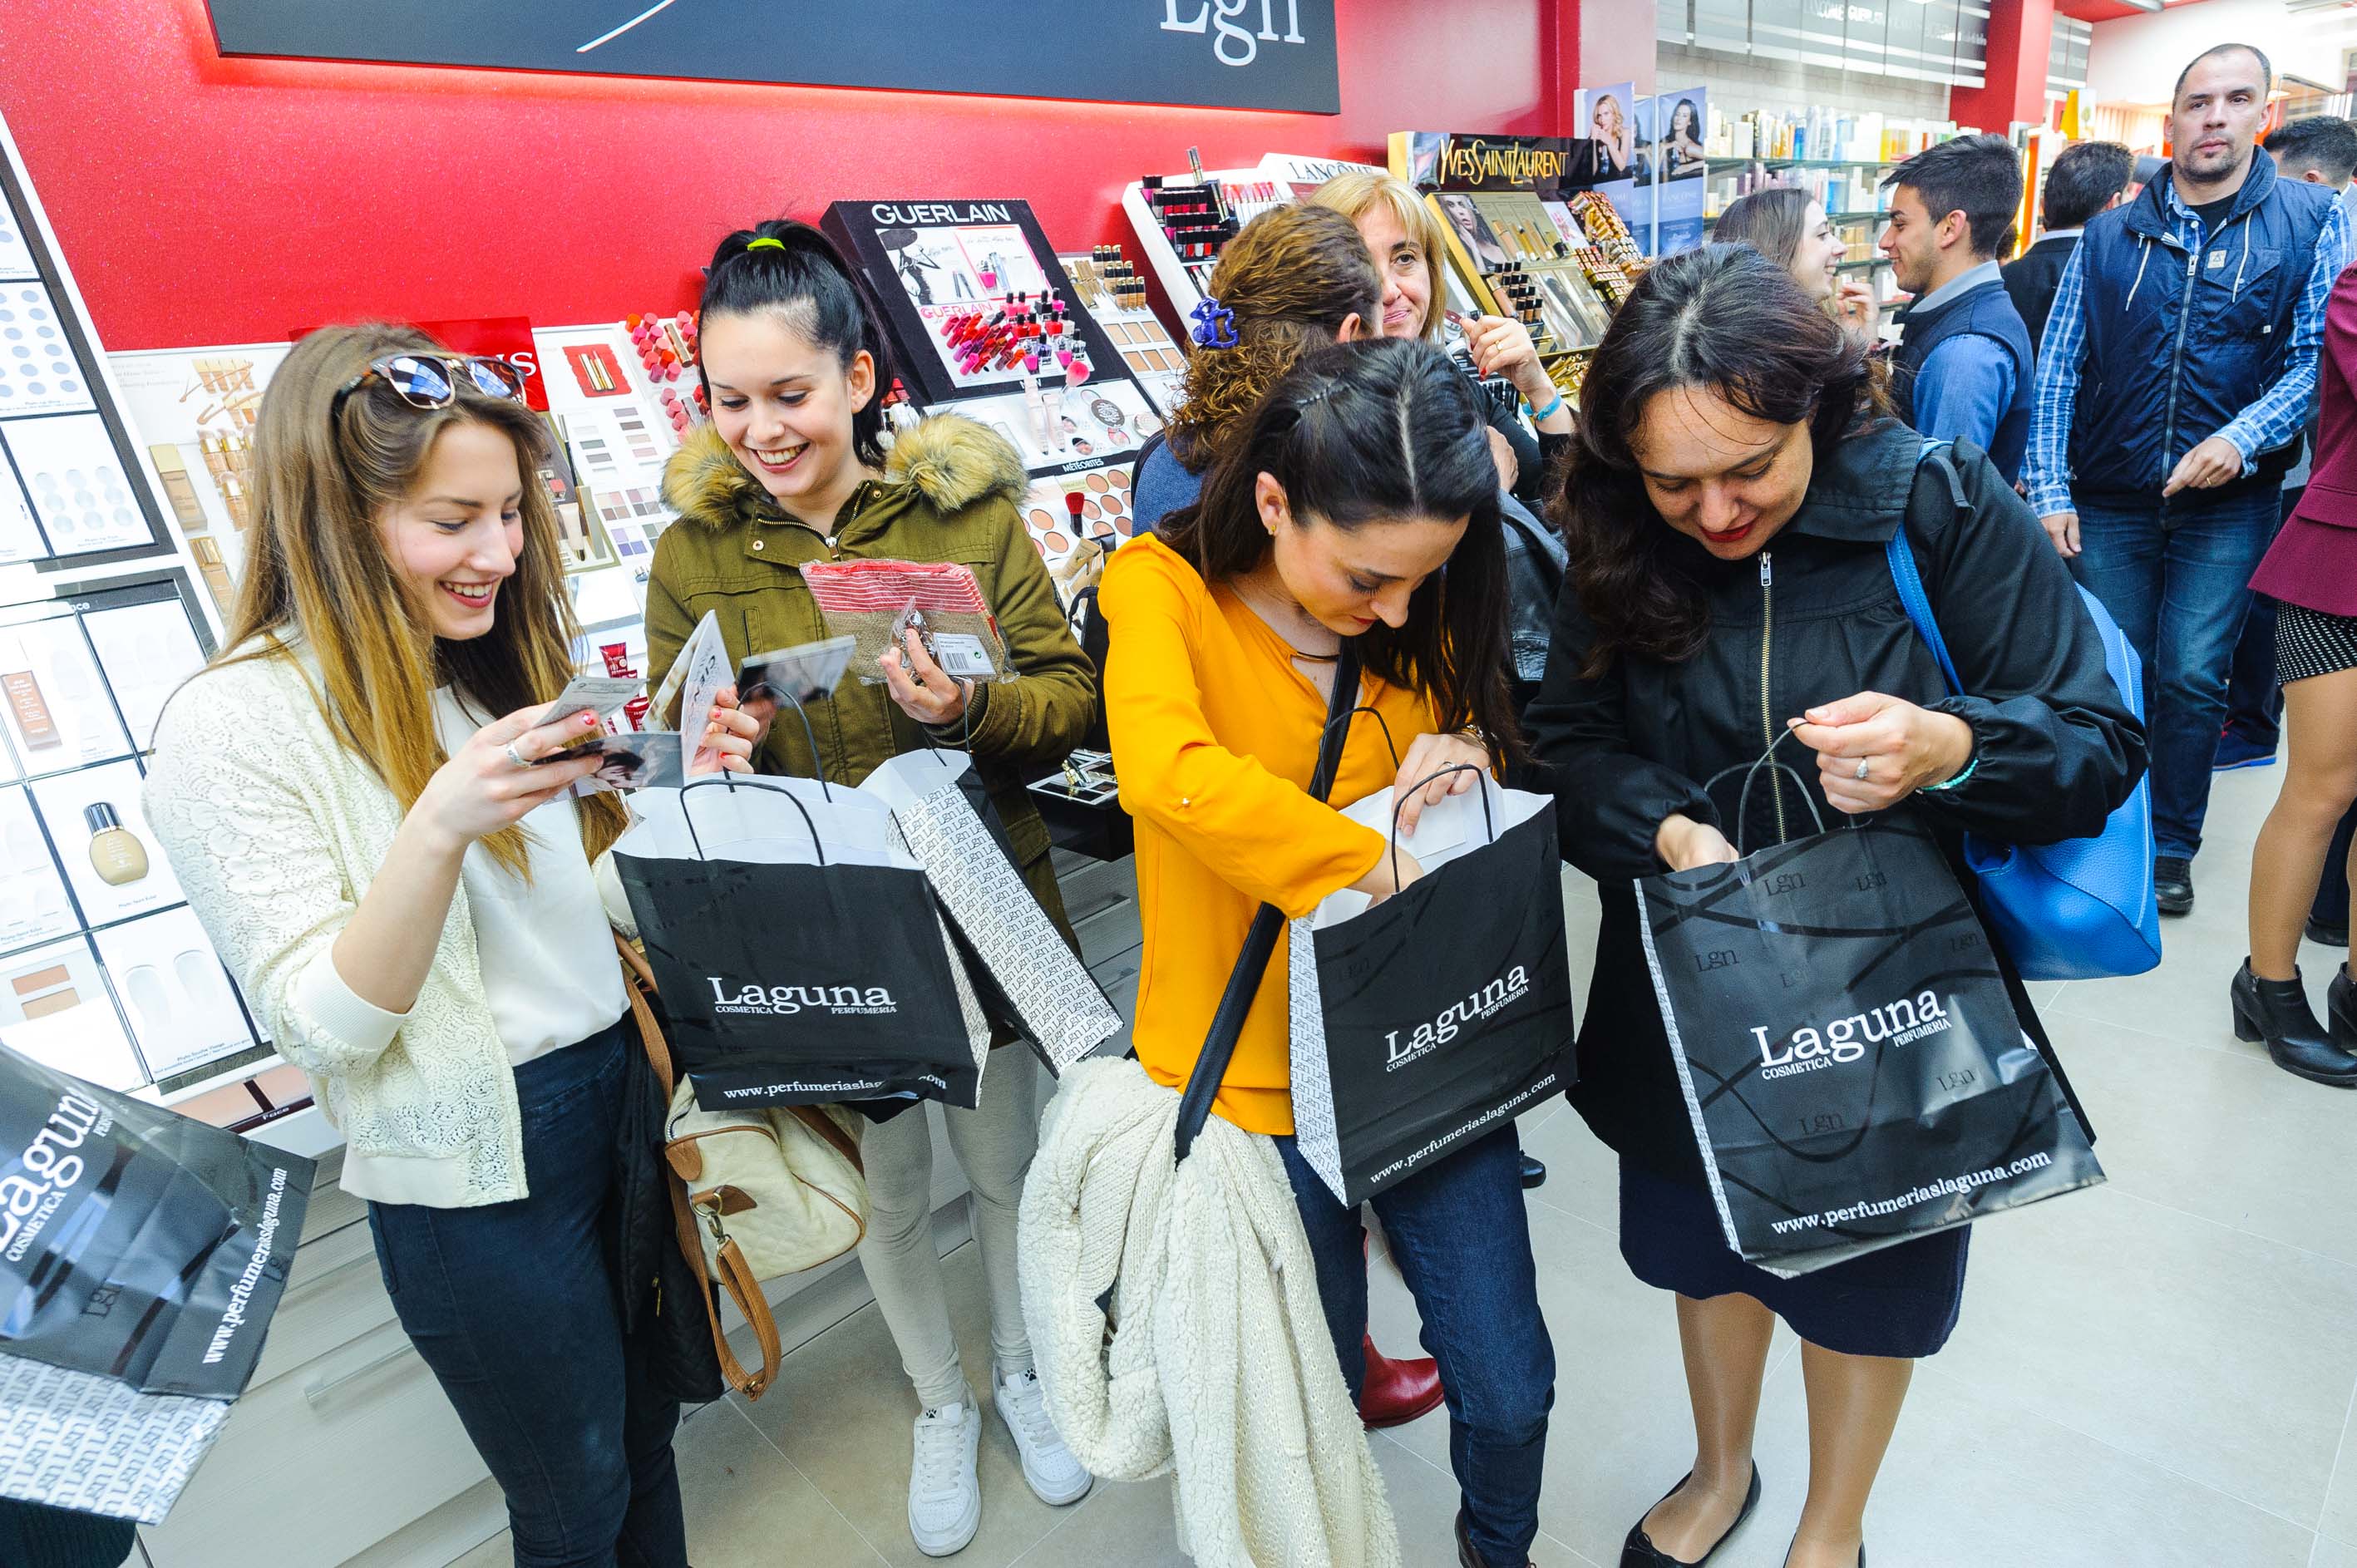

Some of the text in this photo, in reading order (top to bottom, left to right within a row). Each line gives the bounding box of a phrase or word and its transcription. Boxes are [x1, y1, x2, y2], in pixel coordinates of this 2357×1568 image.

[871, 204, 1011, 224] GUERLAIN
[920, 302, 993, 318] GUERLAIN
[1763, 872, 1806, 896] Lgn
[1694, 949, 1740, 973] Lgn
[707, 977, 896, 1014] Laguna
[715, 1005, 897, 1014] COSMETICA PERFUMERIA
[1384, 965, 1531, 1063] Laguna
[1386, 986, 1529, 1072] COSMETICA PERFUMERIA
[1750, 990, 1947, 1068] Laguna
[1761, 1018, 1952, 1080] COSMETICA PERFUMERIA
[1936, 1068, 1976, 1092] Lgn
[1370, 1072, 1556, 1184] www.perfumeriaslaguna.com
[1771, 1151, 2052, 1235] www.perfumeriaslaguna.com
[6, 1191, 67, 1262] COSMETICA
[203, 1167, 288, 1363] www.perfumeriaslaguna.com
